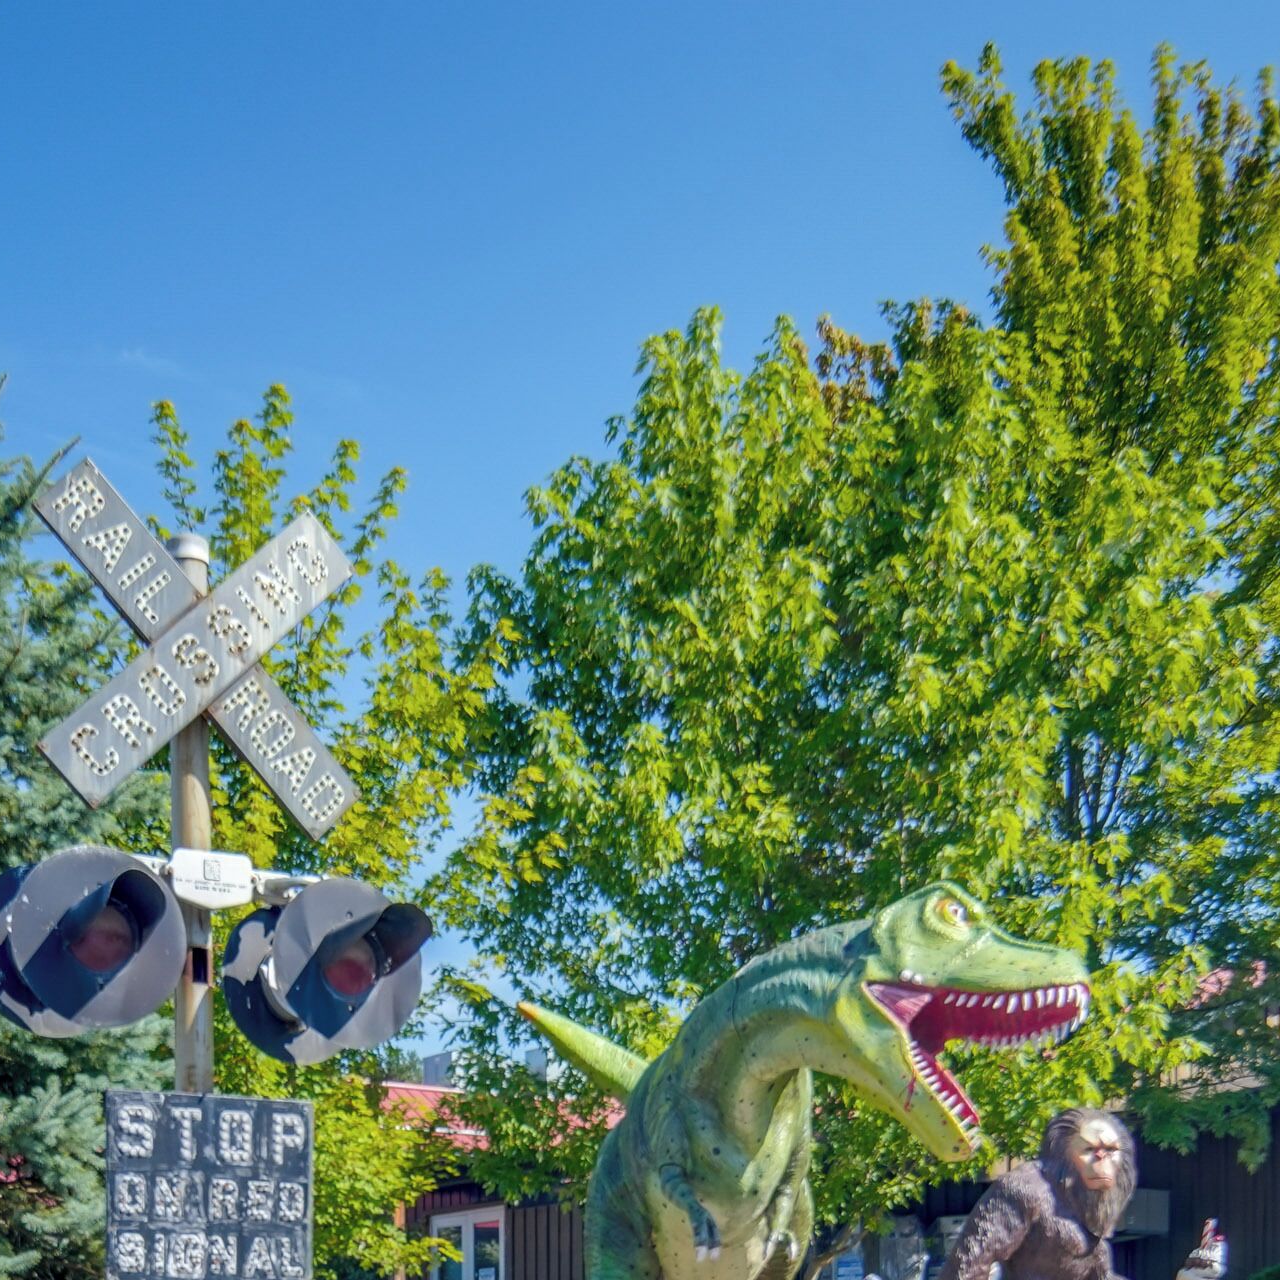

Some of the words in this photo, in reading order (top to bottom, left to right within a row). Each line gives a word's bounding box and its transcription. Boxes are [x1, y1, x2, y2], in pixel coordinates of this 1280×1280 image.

[52, 477, 171, 625] RAIL
[223, 676, 345, 823] ROAD
[71, 535, 329, 776] CROSSING
[118, 1104, 305, 1166] STOP
[115, 1173, 184, 1218] ON
[208, 1178, 305, 1222] RED
[118, 1232, 304, 1279] SIGNAL
